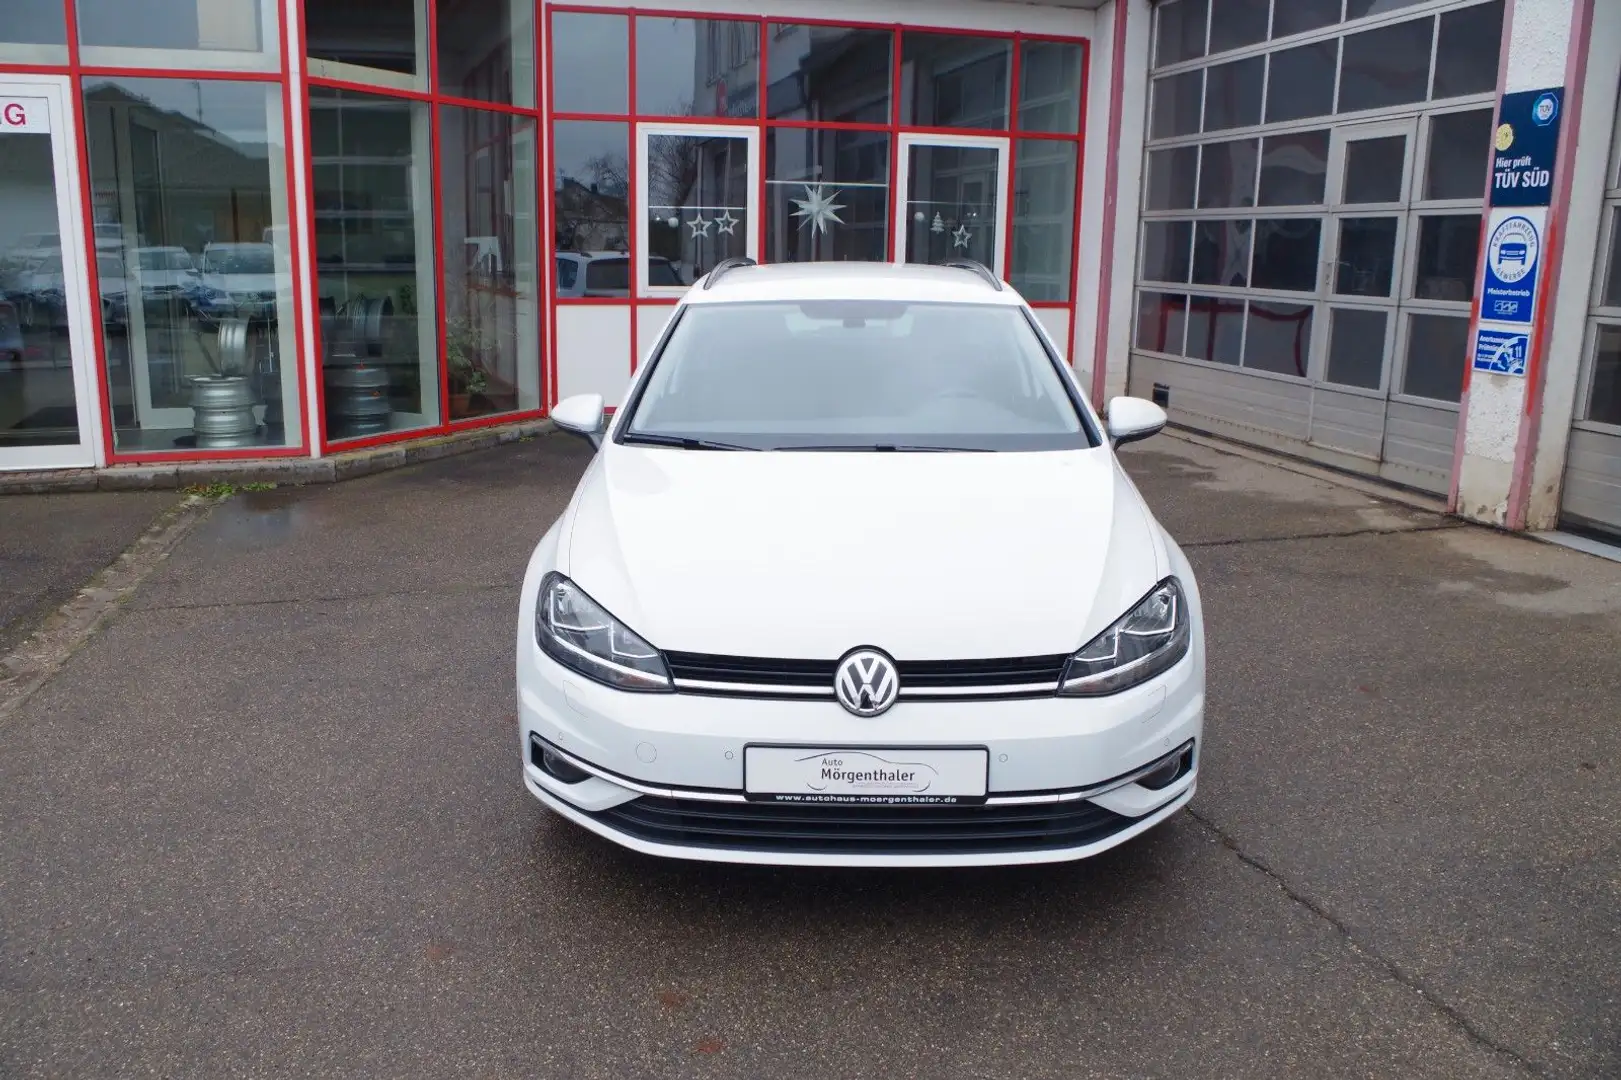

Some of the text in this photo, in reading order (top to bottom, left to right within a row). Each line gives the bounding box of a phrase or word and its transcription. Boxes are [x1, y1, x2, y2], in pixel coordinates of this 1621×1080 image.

[0, 103, 26, 126] G
[1496, 156, 1532, 169] Hier prüft
[1495, 166, 1550, 189] TÜV SÜD
[1487, 288, 1530, 297] Meisterbetrieb
[837, 651, 898, 714] VW
[821, 758, 844, 767] Auto
[821, 768, 915, 783] Mörgenthaler
[775, 794, 957, 804] www.autohaus-moergenthaler.de
